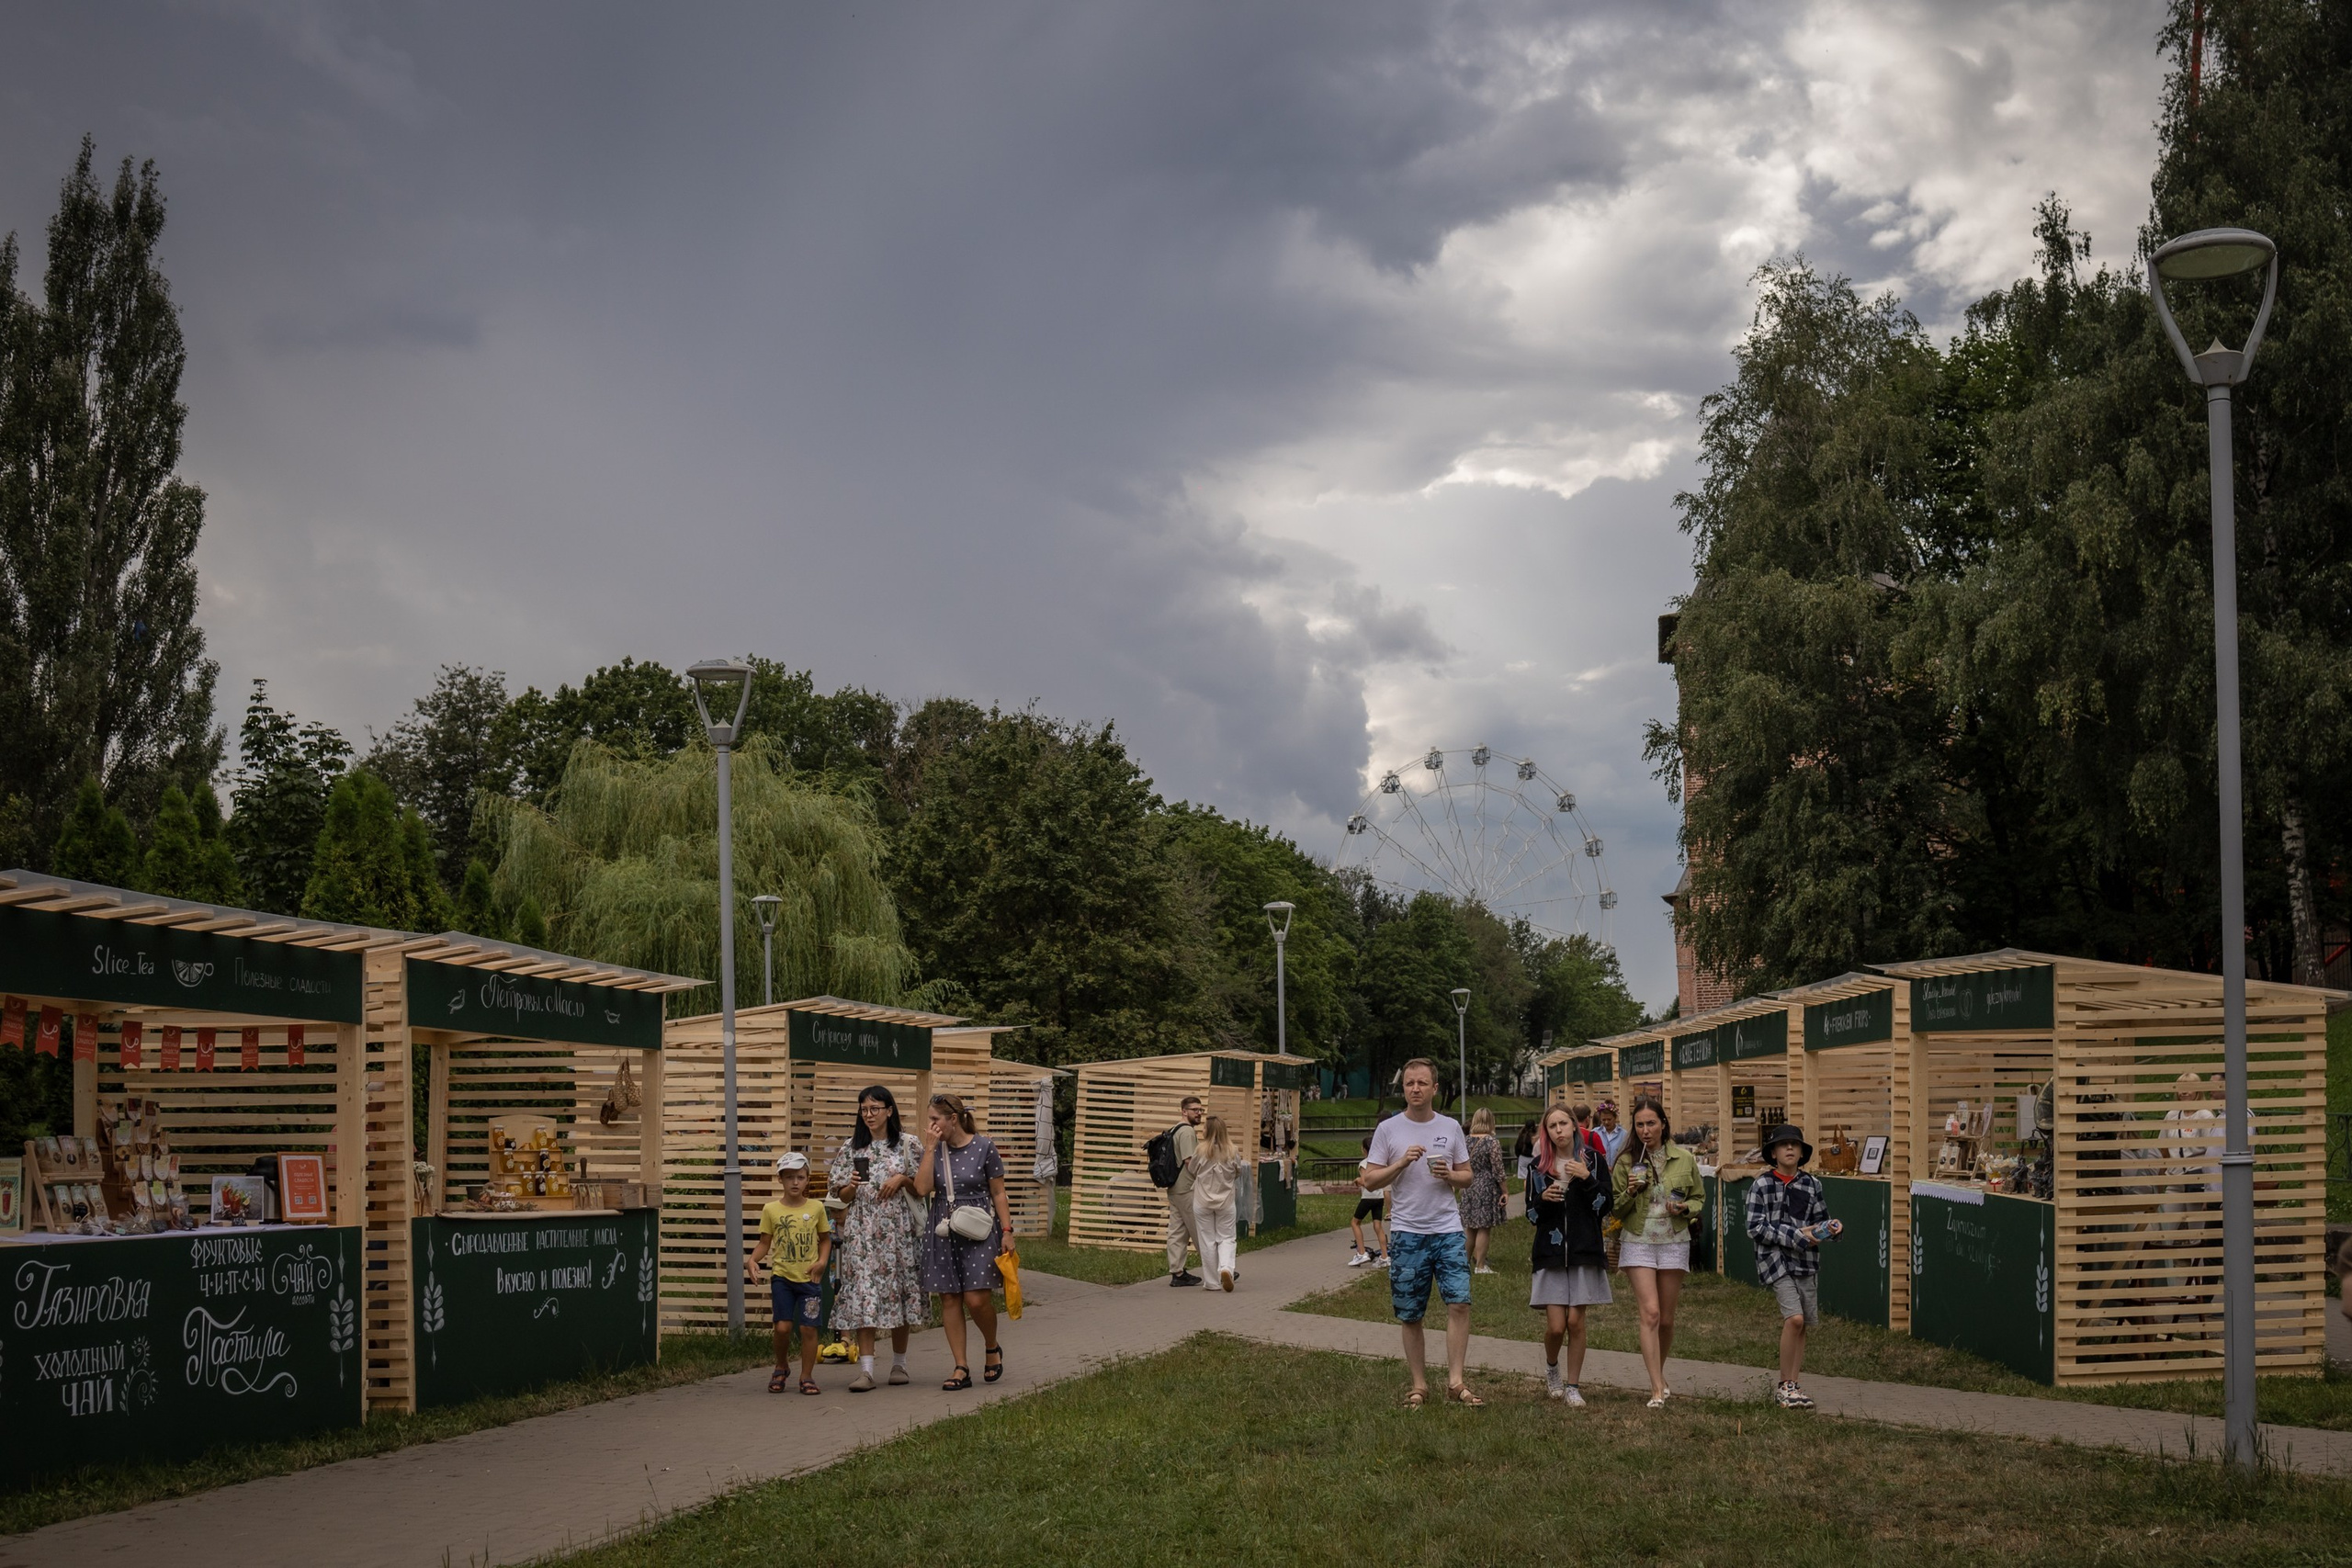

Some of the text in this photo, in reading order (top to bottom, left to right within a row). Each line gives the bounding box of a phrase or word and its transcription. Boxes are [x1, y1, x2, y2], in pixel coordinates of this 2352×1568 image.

[235, 957, 283, 989] Полезные
[190, 1237, 263, 1269] ФРУКТОВЫЕ
[593, 1227, 617, 1246] МАСЛА
[800, 1246, 809, 1258] UP
[288, 1259, 314, 1293] ЧАЙ
[497, 1267, 535, 1294] ВКУСНО
[551, 1258, 593, 1290] ПОЛЕЗНО!
[34, 1339, 125, 1382] ХОЛОДНЫЙ
[183, 1305, 297, 1397] Пастила
[62, 1374, 114, 1416] ЧАЙ
